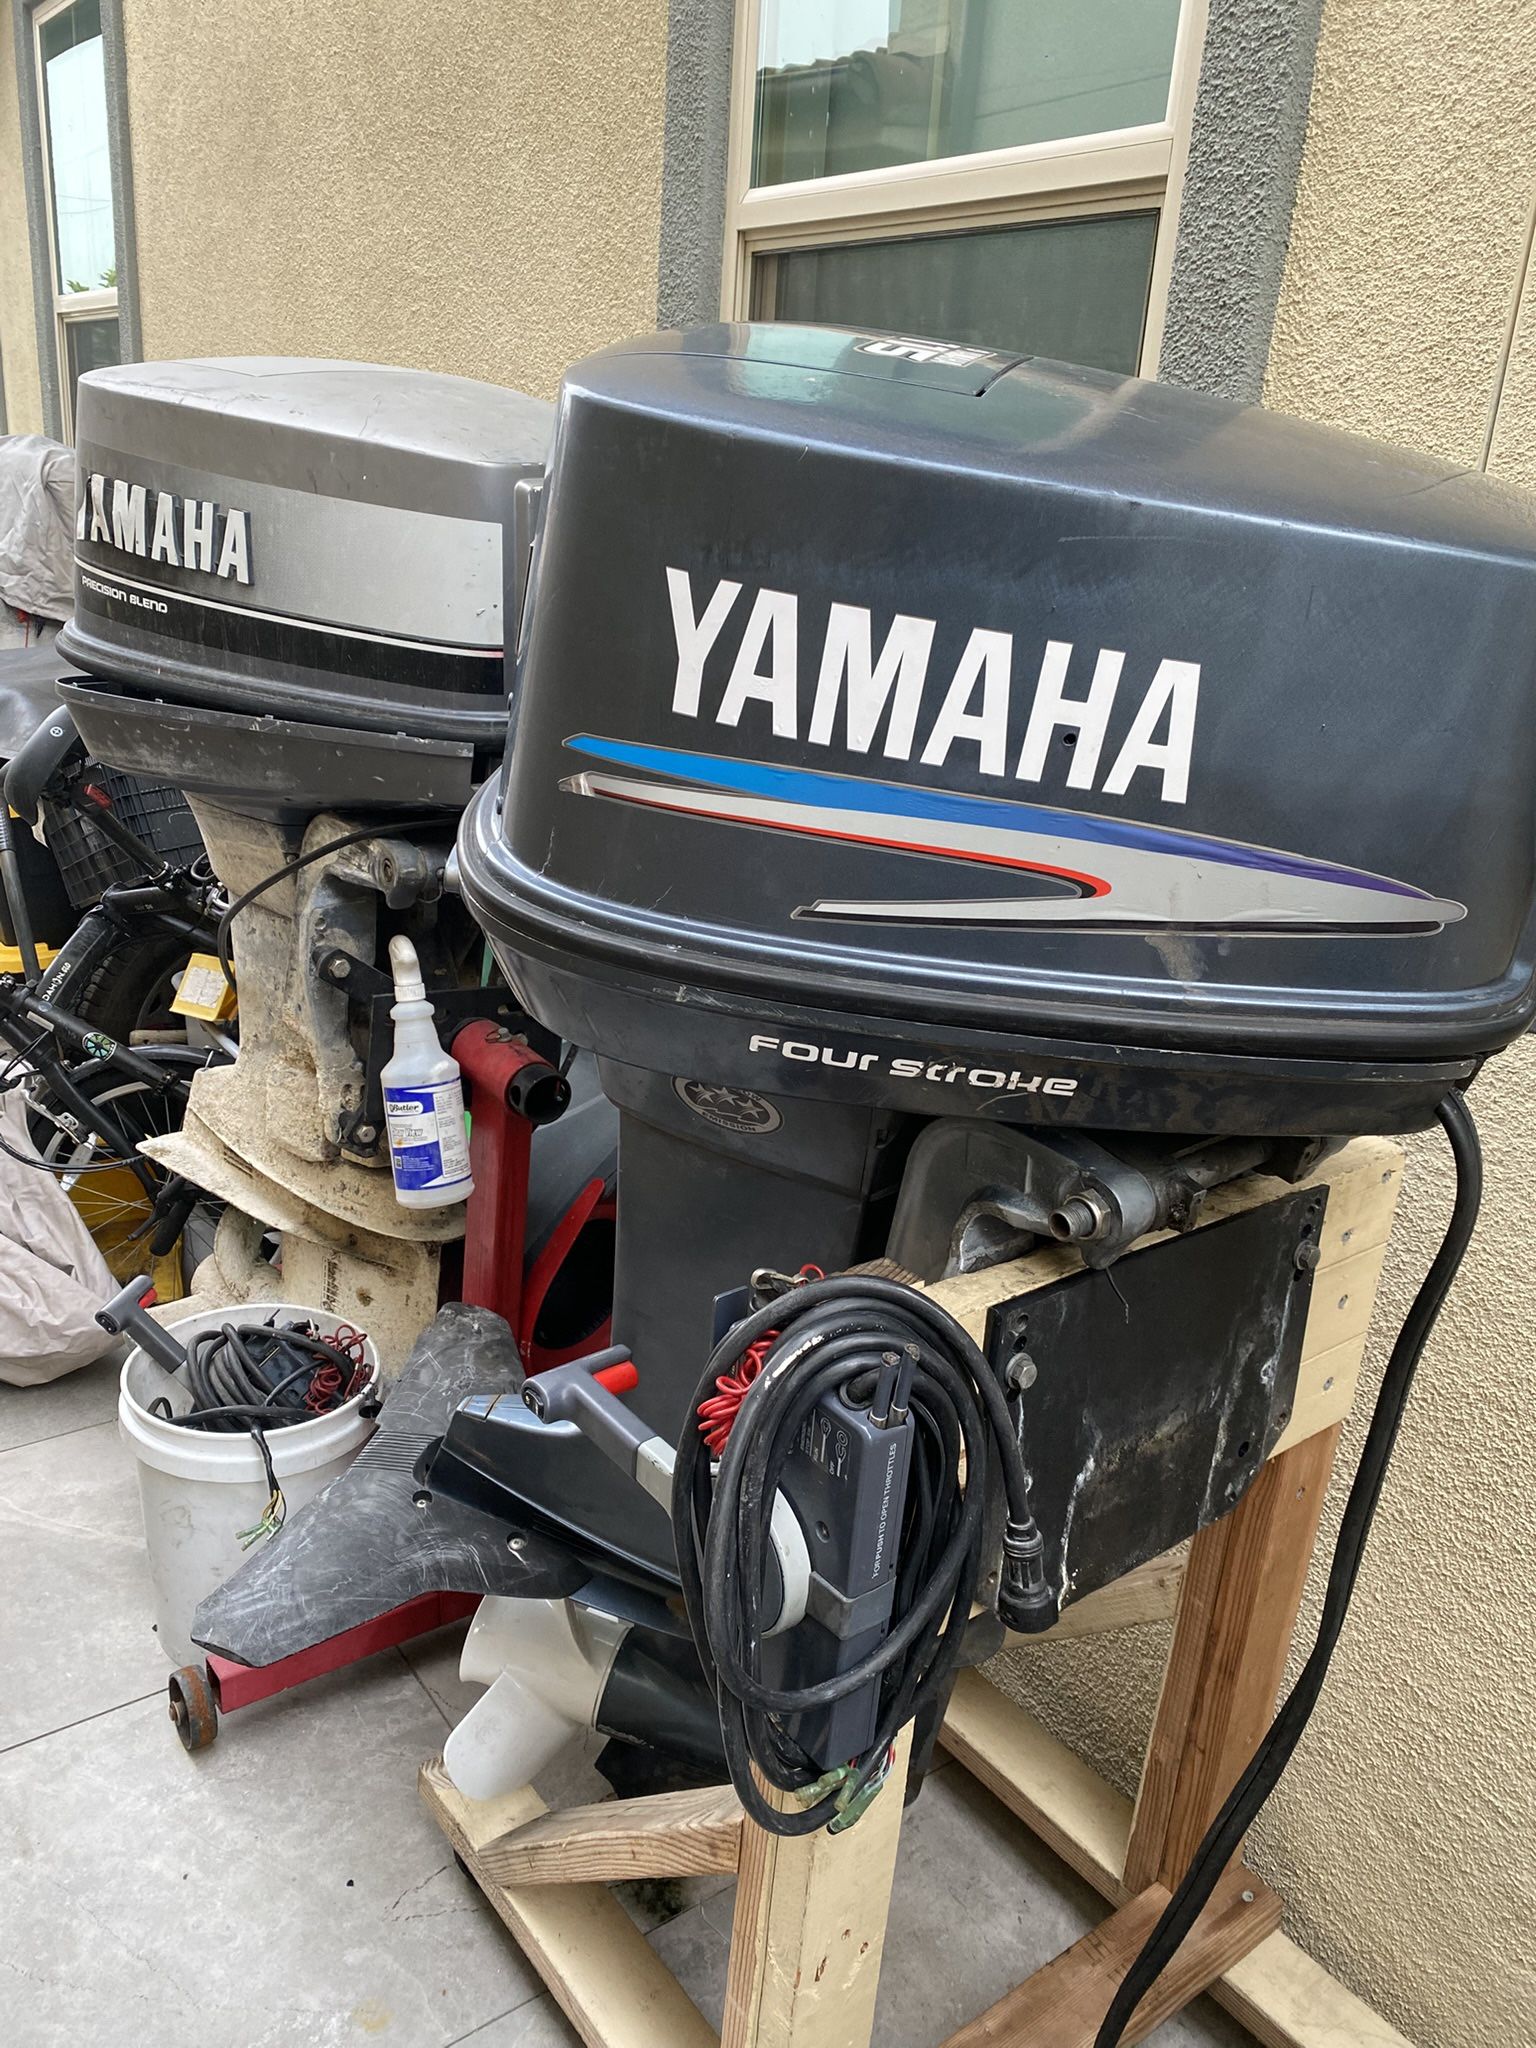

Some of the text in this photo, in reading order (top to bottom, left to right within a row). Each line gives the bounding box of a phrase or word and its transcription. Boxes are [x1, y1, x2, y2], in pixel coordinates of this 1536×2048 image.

[81, 575, 168, 614] PRECISION BLEND
[666, 566, 1201, 804] YAMAHA
[701, 1111, 756, 1132] EMISSION
[884, 1443, 897, 1495] THROTTLES
[880, 1495, 890, 1520] OPEN
[878, 1522, 887, 1535] TO
[875, 1534, 884, 1560] PUSH
